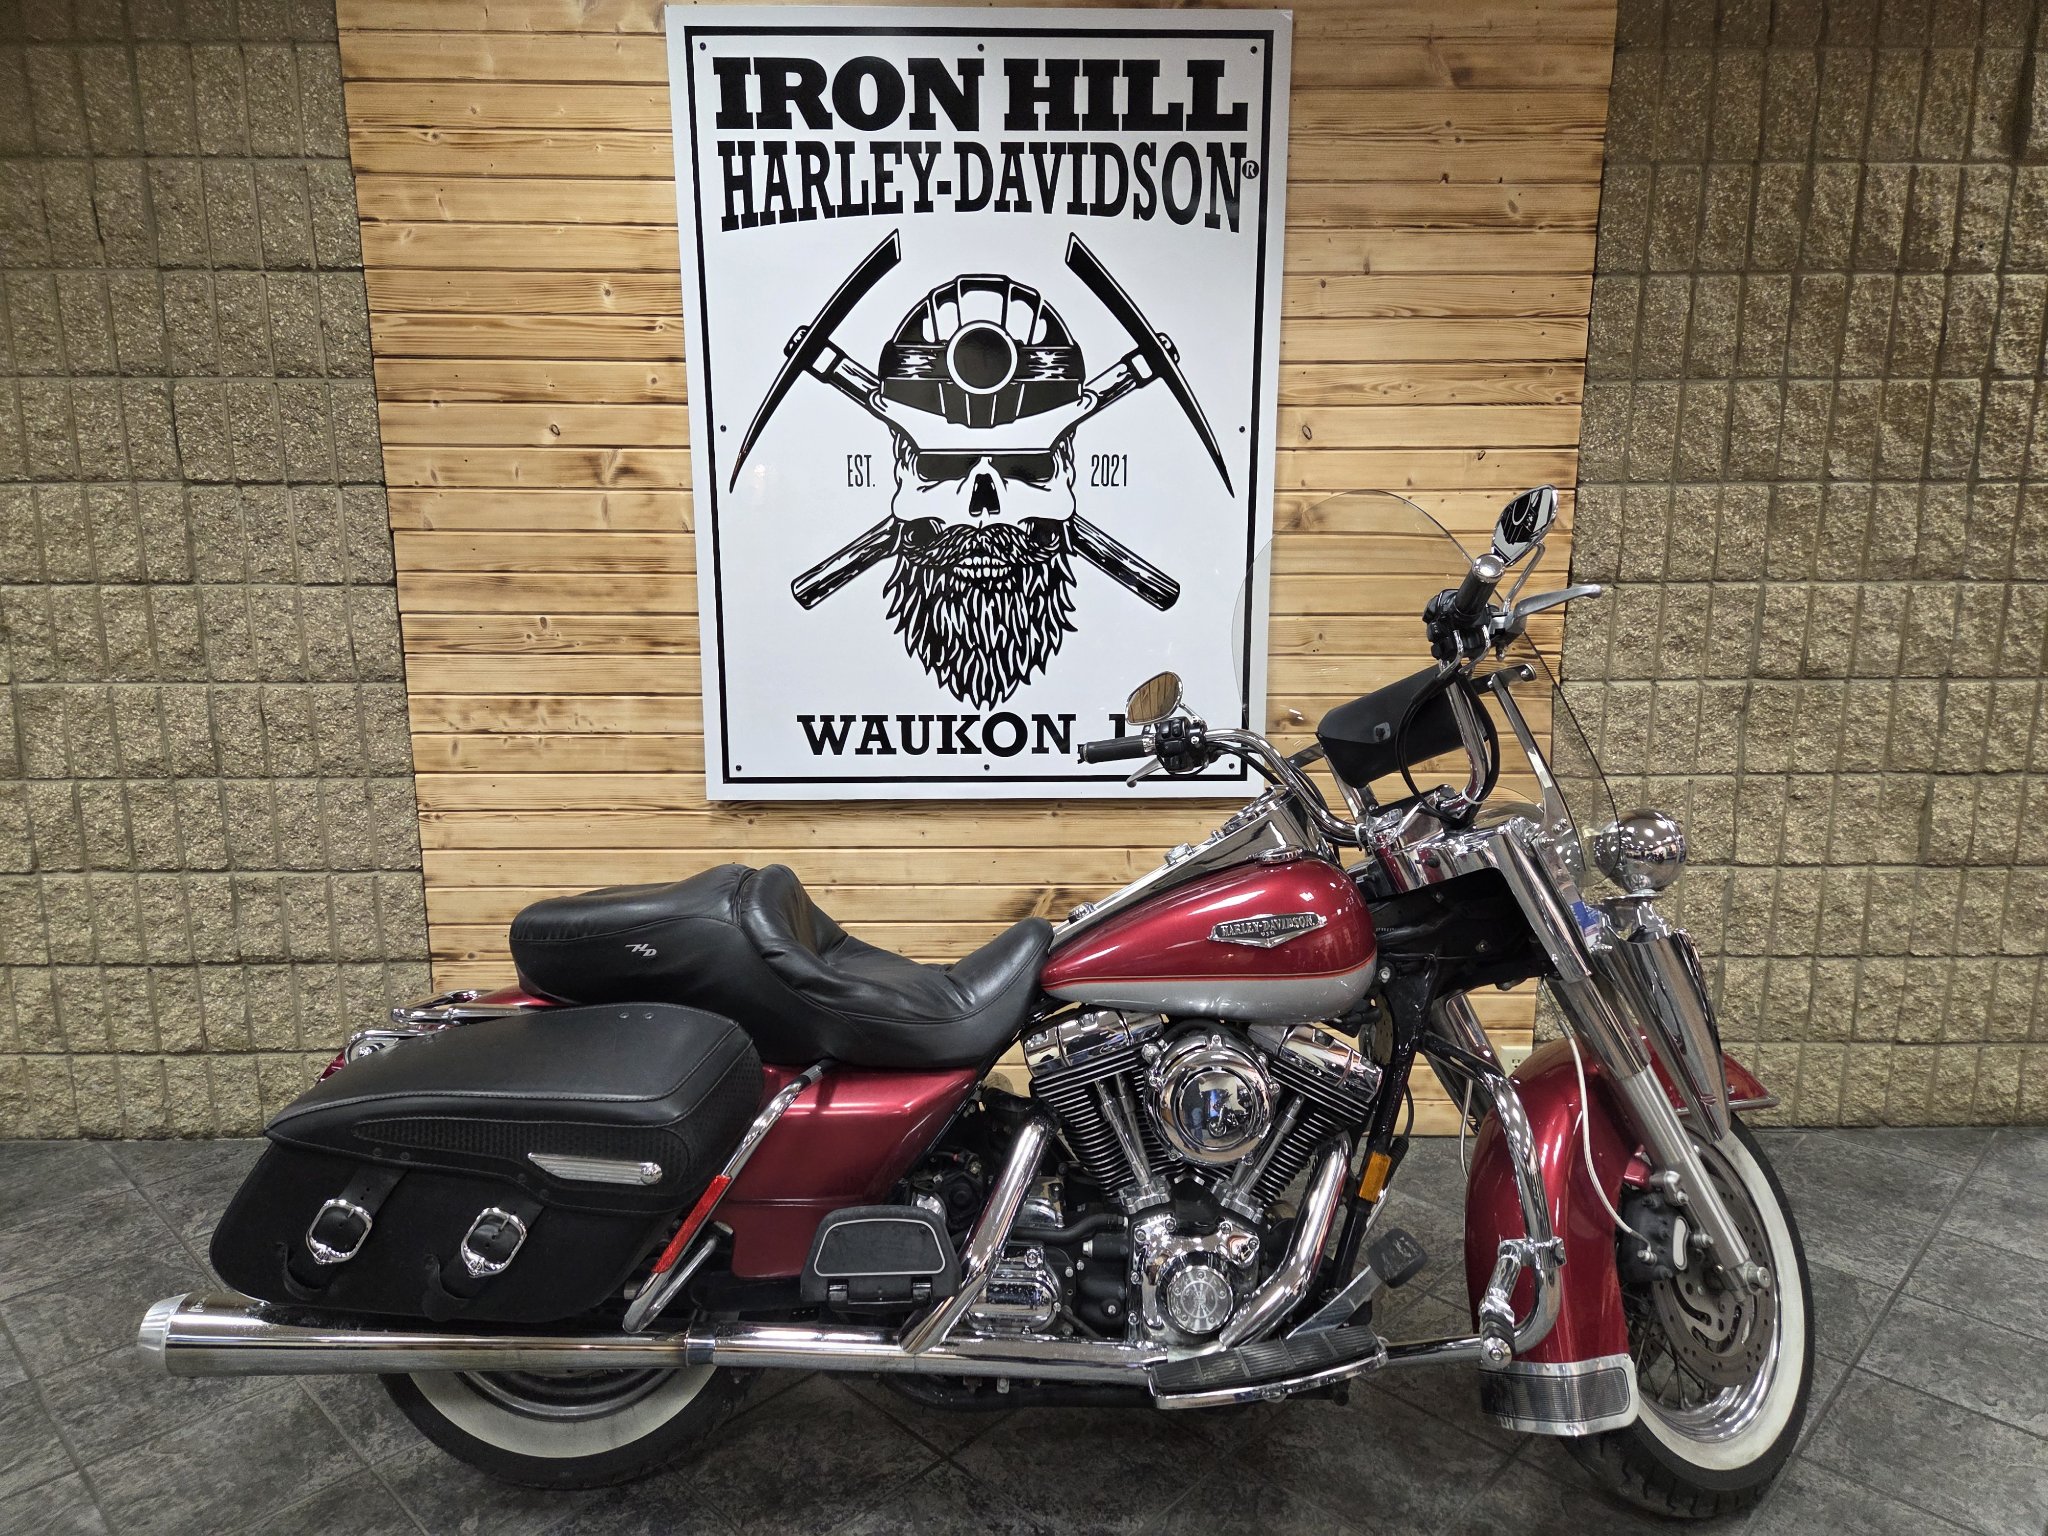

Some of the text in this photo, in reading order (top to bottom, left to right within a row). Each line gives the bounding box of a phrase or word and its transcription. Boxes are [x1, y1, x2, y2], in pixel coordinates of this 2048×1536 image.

[712, 55, 1249, 132] IRON HILL
[846, 454, 876, 488] EST.
[1090, 454, 1128, 487] 2021
